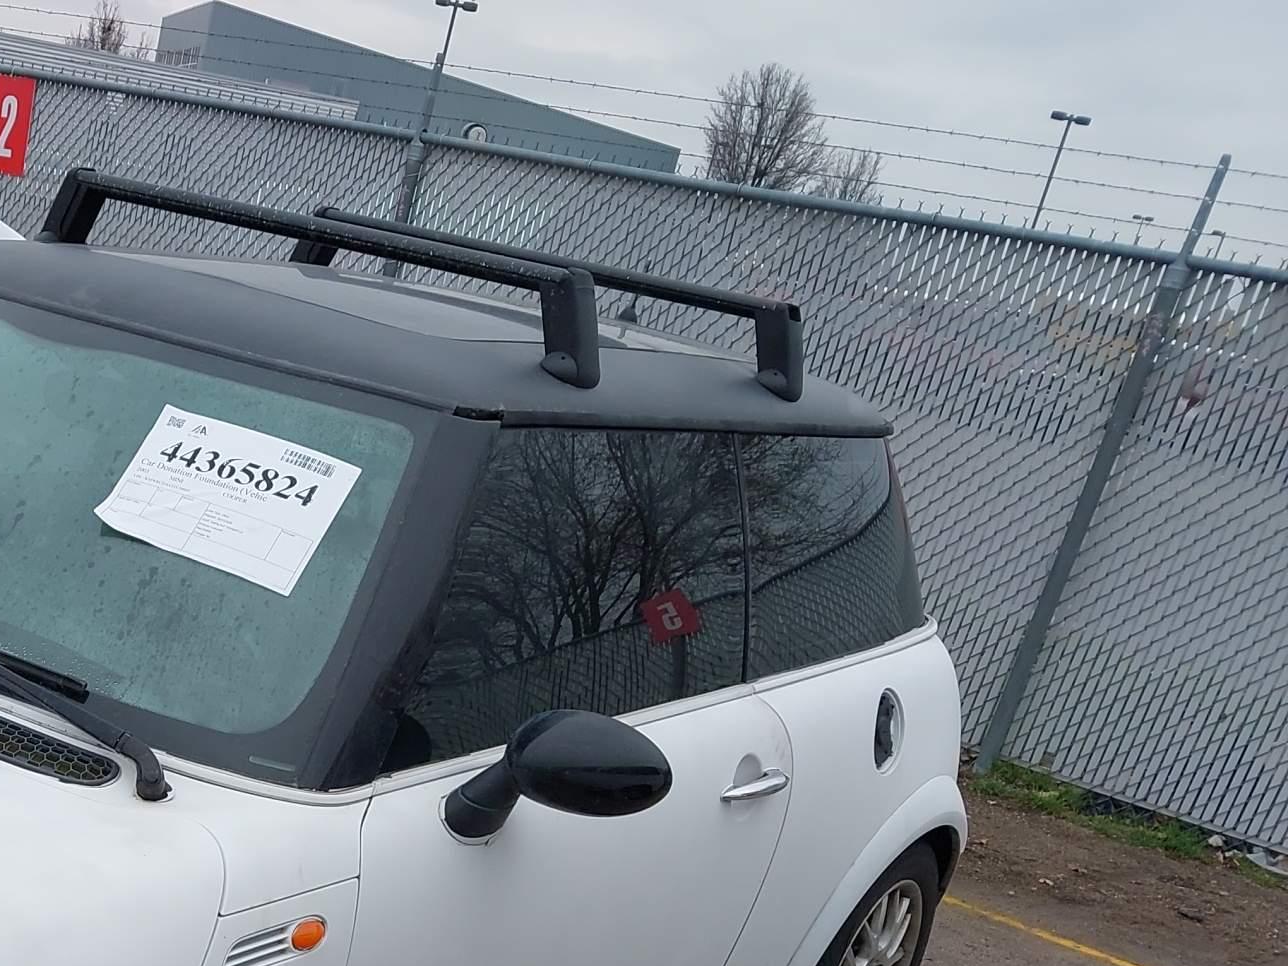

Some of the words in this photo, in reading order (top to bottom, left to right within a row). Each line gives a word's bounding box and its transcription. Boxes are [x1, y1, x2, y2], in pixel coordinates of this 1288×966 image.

[141, 457, 156, 467] Car
[156, 461, 193, 479] Donation
[194, 473, 239, 493] Foundation
[159, 441, 321, 508] 44365824
